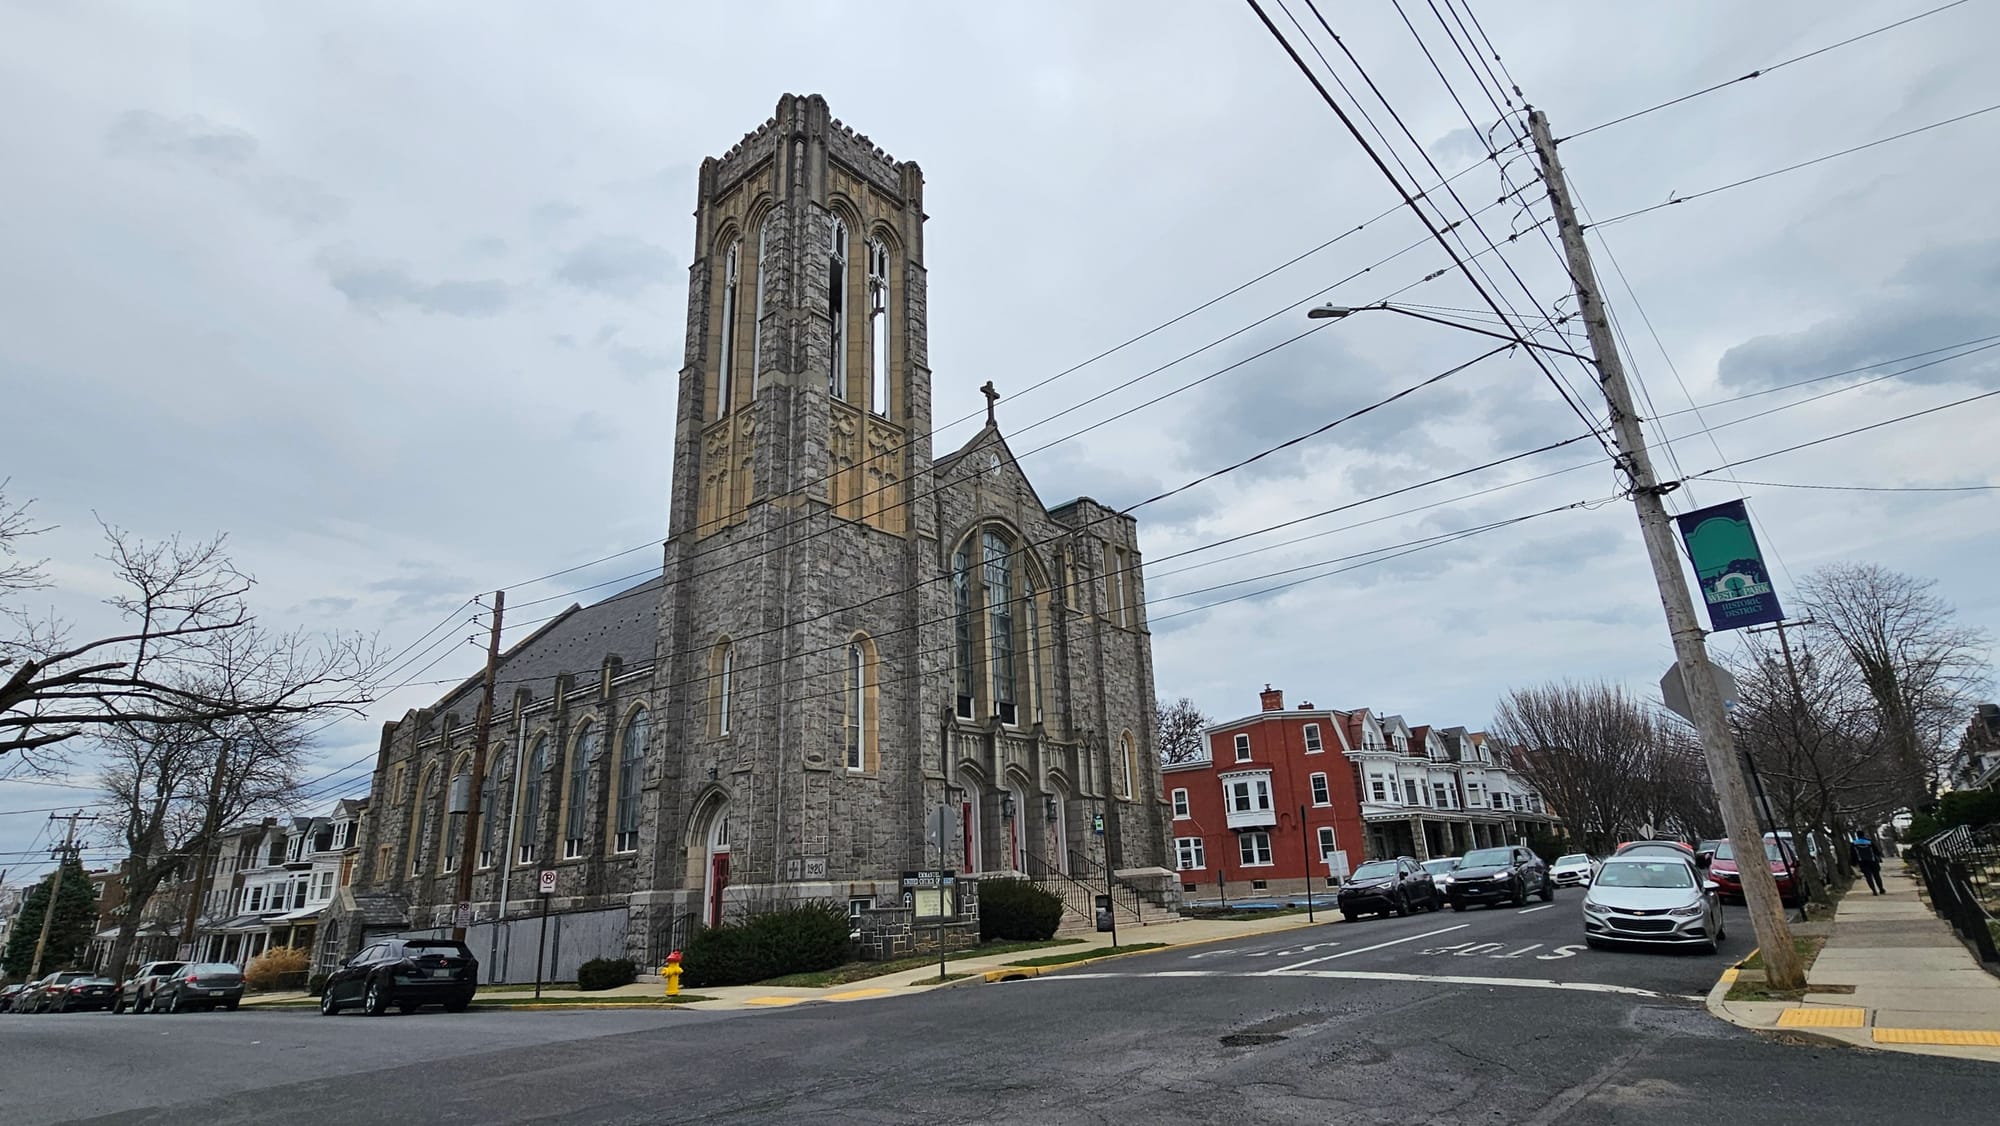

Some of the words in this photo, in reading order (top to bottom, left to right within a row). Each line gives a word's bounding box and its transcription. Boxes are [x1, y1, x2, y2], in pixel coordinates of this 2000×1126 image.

[1708, 591, 1734, 603] WEST
[1744, 584, 1770, 596] PARK
[1722, 597, 1761, 611] HISTORIC
[1725, 605, 1763, 618] DISTRICT
[807, 863, 824, 874] 1920
